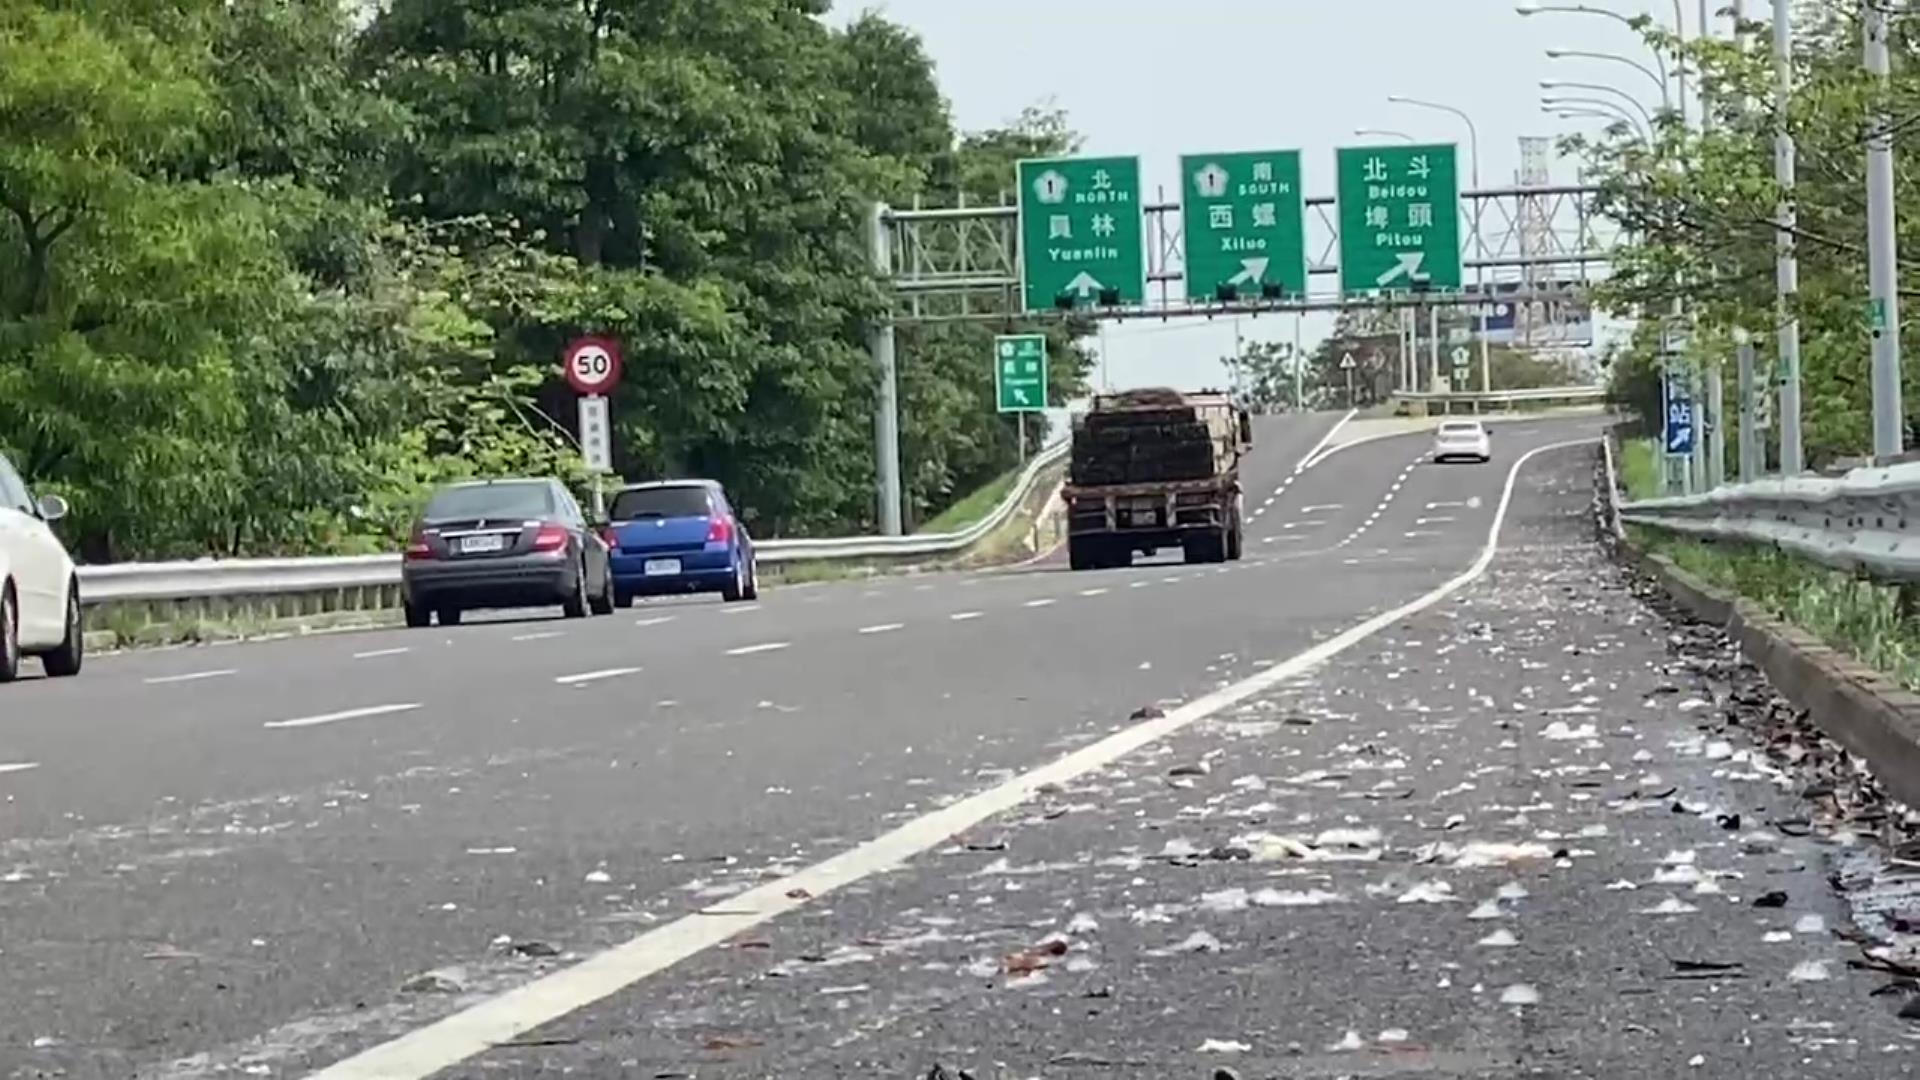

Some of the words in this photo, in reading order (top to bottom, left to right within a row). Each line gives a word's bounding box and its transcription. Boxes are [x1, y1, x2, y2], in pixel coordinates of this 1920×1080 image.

[1252, 162, 1272, 182] 南
[1362, 154, 1431, 182] 北斗
[1091, 168, 1112, 190] 北
[1239, 182, 1289, 196] SOUTH
[1075, 190, 1128, 204] NORTH
[1368, 184, 1428, 199] Beidou
[1208, 202, 1276, 229] 西螺
[1364, 202, 1433, 230] 埤頭
[1048, 213, 1116, 239] 員林
[1221, 236, 1267, 251] Xiluo
[1375, 232, 1423, 247] Pitou
[1048, 246, 1118, 262] Yuanlin
[578, 355, 607, 376] 50
